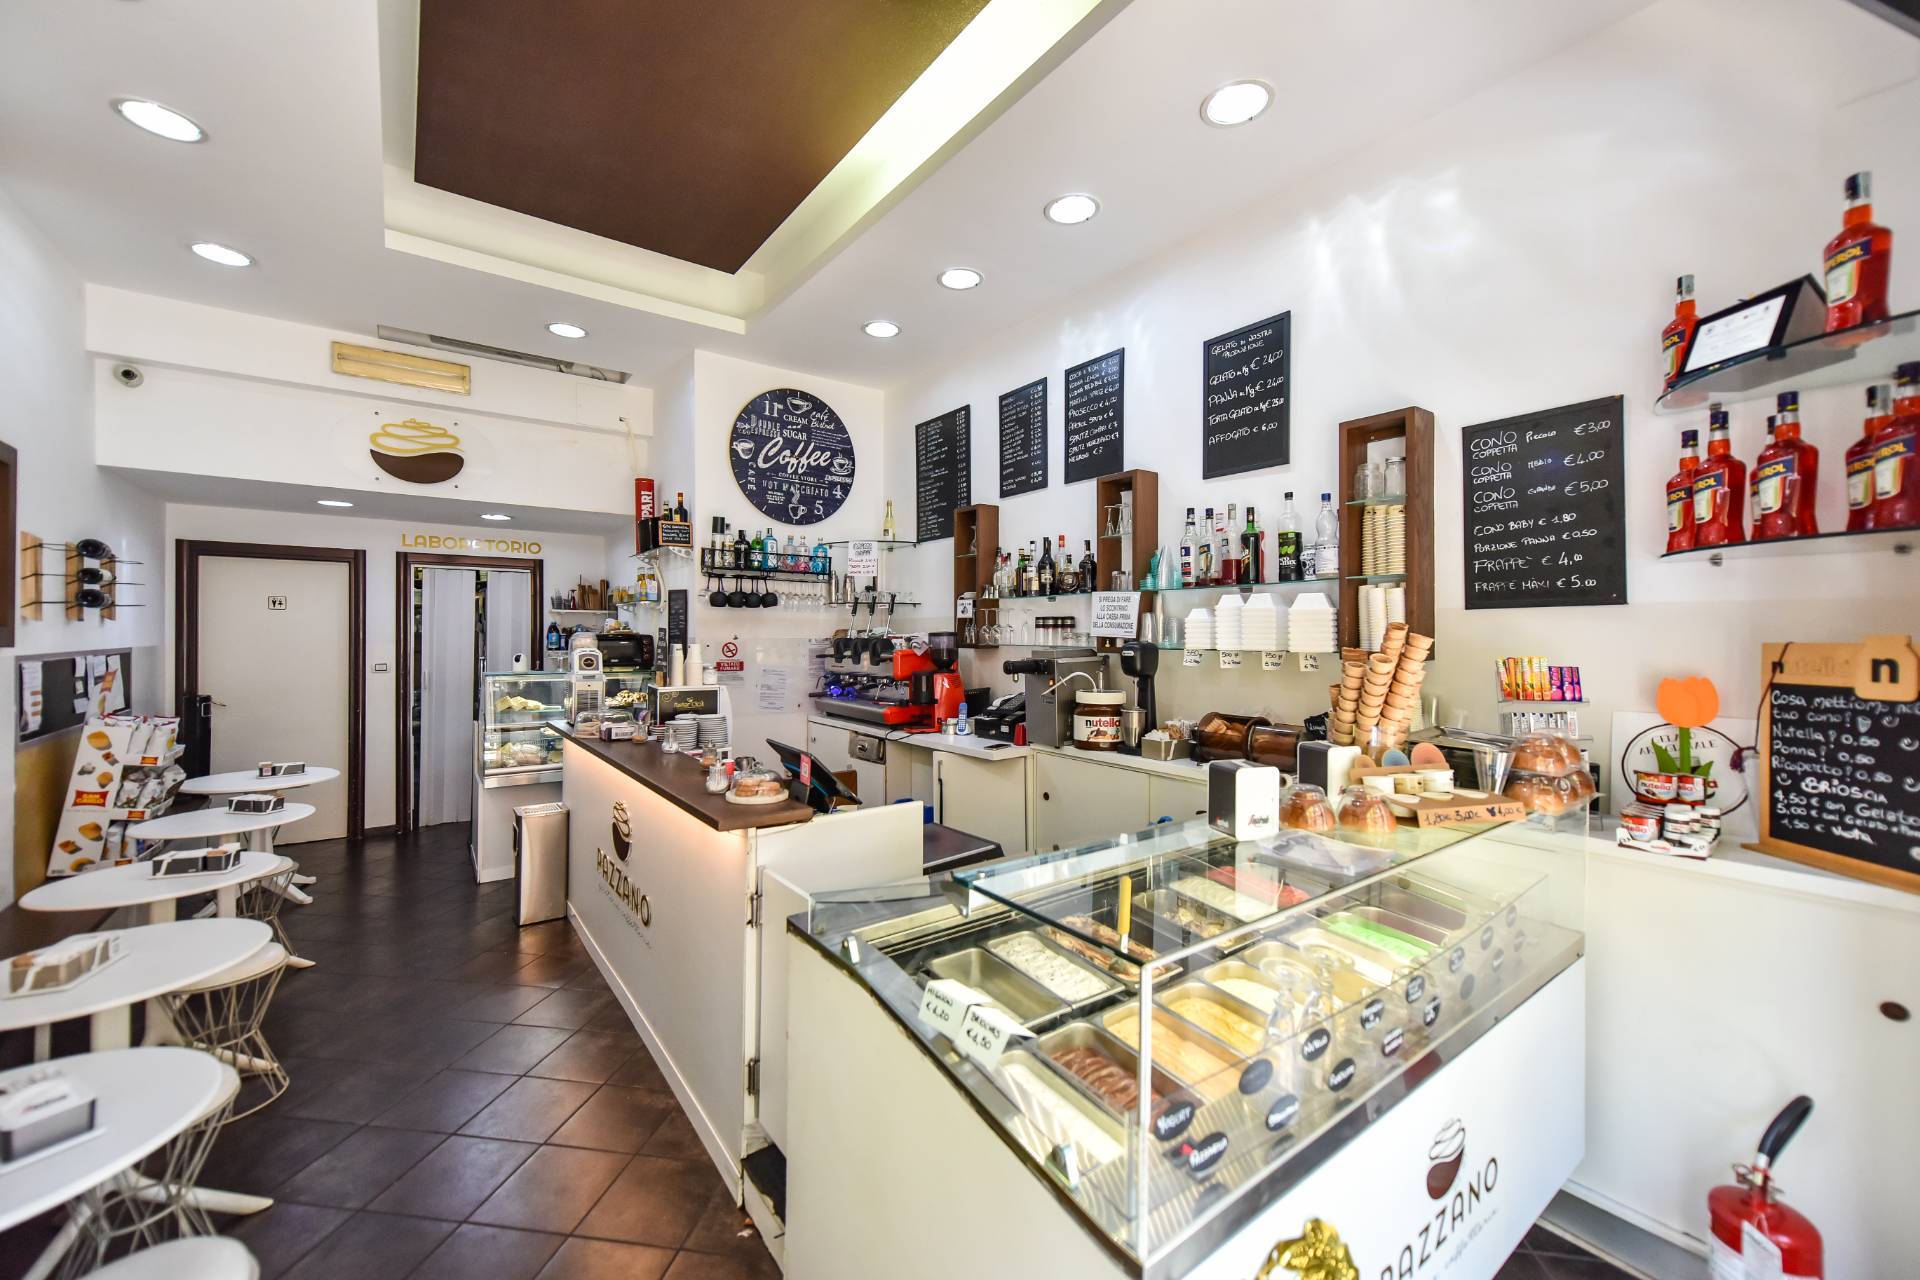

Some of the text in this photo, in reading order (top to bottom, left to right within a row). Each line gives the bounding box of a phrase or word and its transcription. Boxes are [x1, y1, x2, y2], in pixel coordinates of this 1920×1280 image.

[1211, 329, 1273, 355] GELATO NOSTRA
[1222, 340, 1264, 359] PRODUZIONE
[1209, 370, 1236, 386] GELATO
[1242, 364, 1249, 377] Kg
[1250, 358, 1260, 370] €
[1262, 350, 1283, 366] 24,00
[1208, 390, 1238, 408] PANNA
[1255, 381, 1265, 393] €
[1267, 376, 1284, 389] 24,00
[1069, 404, 1098, 419] PROSECCO
[1208, 412, 1229, 427] TORTA
[1229, 406, 1252, 420] GELATO
[1266, 400, 1271, 410] €
[783, 415, 808, 425] CREAM
[783, 430, 808, 440] SUGAR
[1069, 431, 1090, 445] SPRITZ
[1208, 427, 1250, 446] AFFOGATO
[1262, 422, 1278, 432] 6,00
[1470, 431, 1517, 452] CONO
[1574, 424, 1587, 436] €
[1588, 420, 1611, 433] 3,00
[758, 437, 831, 474] Coffee
[1069, 444, 1086, 456] SPRITZ
[1473, 444, 1518, 460] COPPETTA
[1471, 461, 1512, 477] CONO
[1564, 454, 1576, 466] €
[1473, 472, 1512, 484] COPPETTA
[783, 483, 829, 498] MACCHIATO
[832, 484, 842, 499] 4
[1473, 486, 1516, 504] CONO
[1564, 482, 1578, 496] €
[1580, 480, 1609, 493] 5,00
[641, 491, 653, 520] PARI
[814, 500, 823, 515] 5
[1474, 501, 1519, 513] COPPETTA
[1474, 524, 1505, 536] CONO
[1508, 519, 1534, 530] BABY
[1538, 518, 1547, 526] €
[402, 534, 542, 554] LABORTORIO
[1474, 542, 1518, 553] PORZIONE
[1521, 535, 1556, 545] PANNA
[1562, 531, 1571, 540] €
[1541, 556, 1552, 566] €
[1556, 578, 1567, 588] €
[1105, 622, 1134, 630] CONSUMAZIONE
[1772, 690, 1807, 707] Cosa
[1773, 709, 1799, 720] tuo
[1086, 718, 1120, 728] nutella
[1772, 724, 1825, 742] Nutella
[1641, 782, 1671, 792] nutella
[1810, 798, 1820, 807] €
[1810, 809, 1819, 818] €
[1814, 823, 1825, 833] €
[597, 848, 651, 927] PAZZANO
